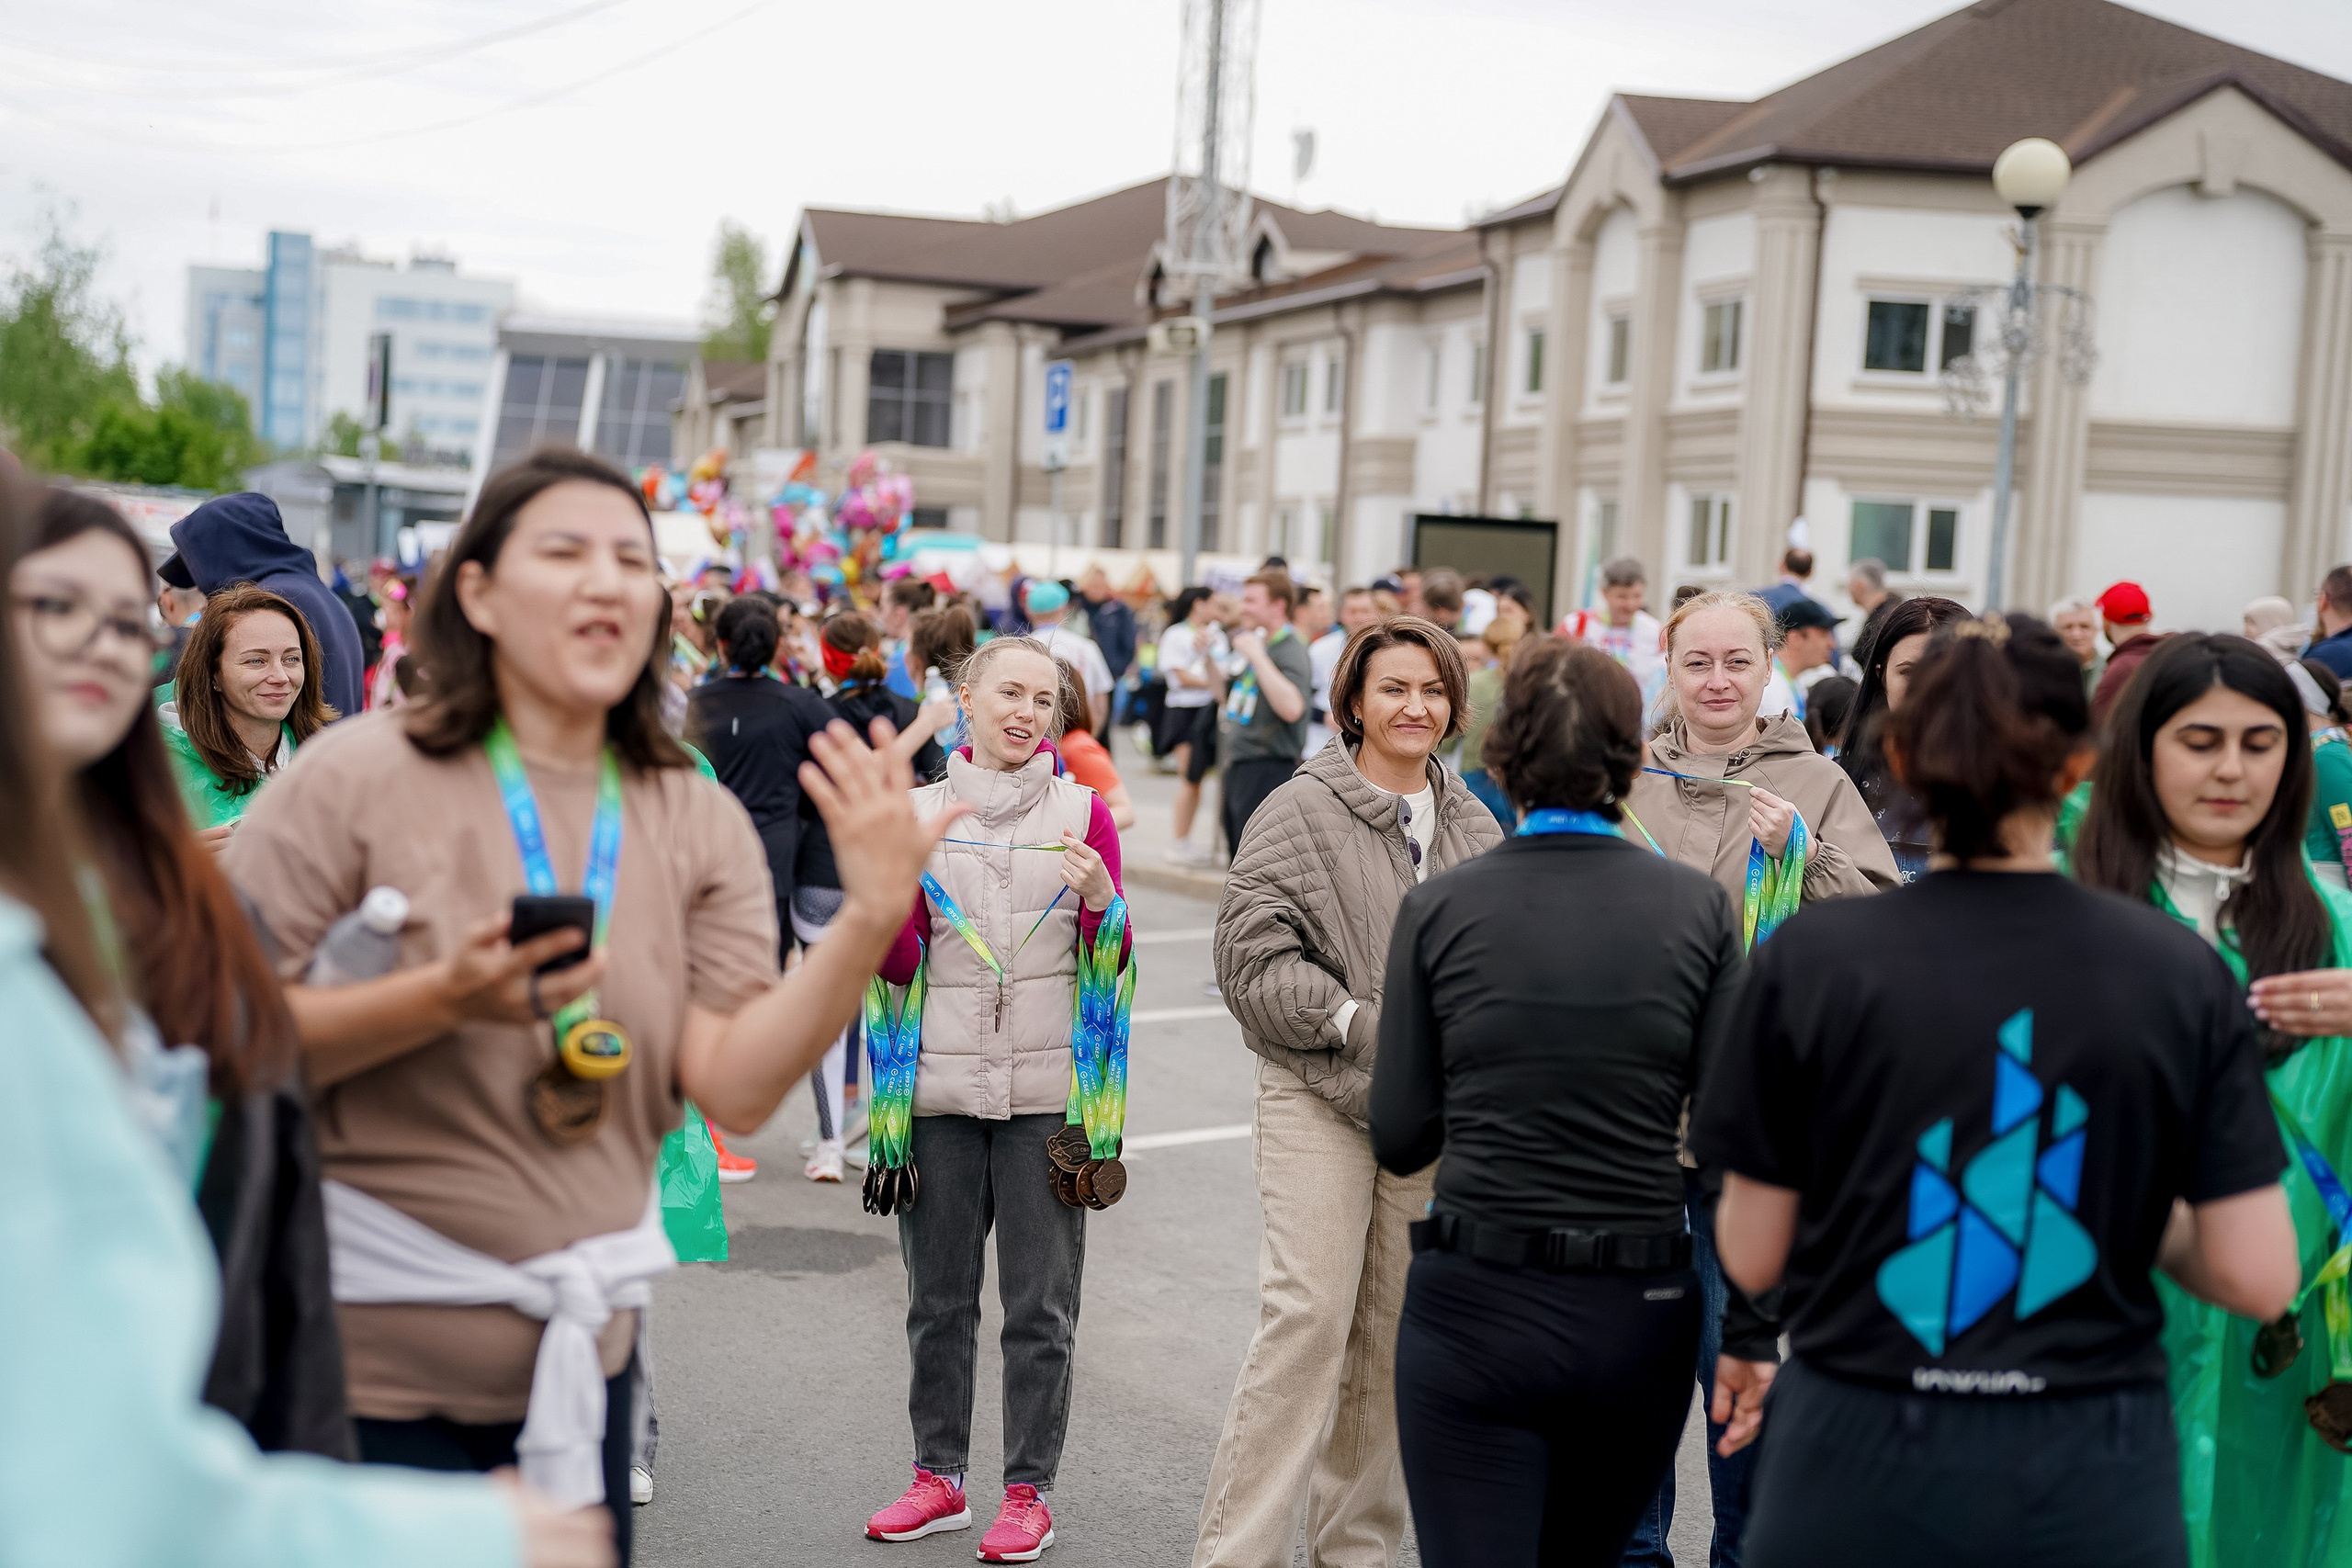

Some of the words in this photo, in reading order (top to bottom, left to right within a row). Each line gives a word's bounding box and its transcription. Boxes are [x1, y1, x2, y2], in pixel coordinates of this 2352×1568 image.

[925, 880, 935, 892] Utair
[945, 907, 960, 921] СБЕР
[888, 1077, 896, 1094] СБЕР
[1082, 1080, 1091, 1097] СБЕР
